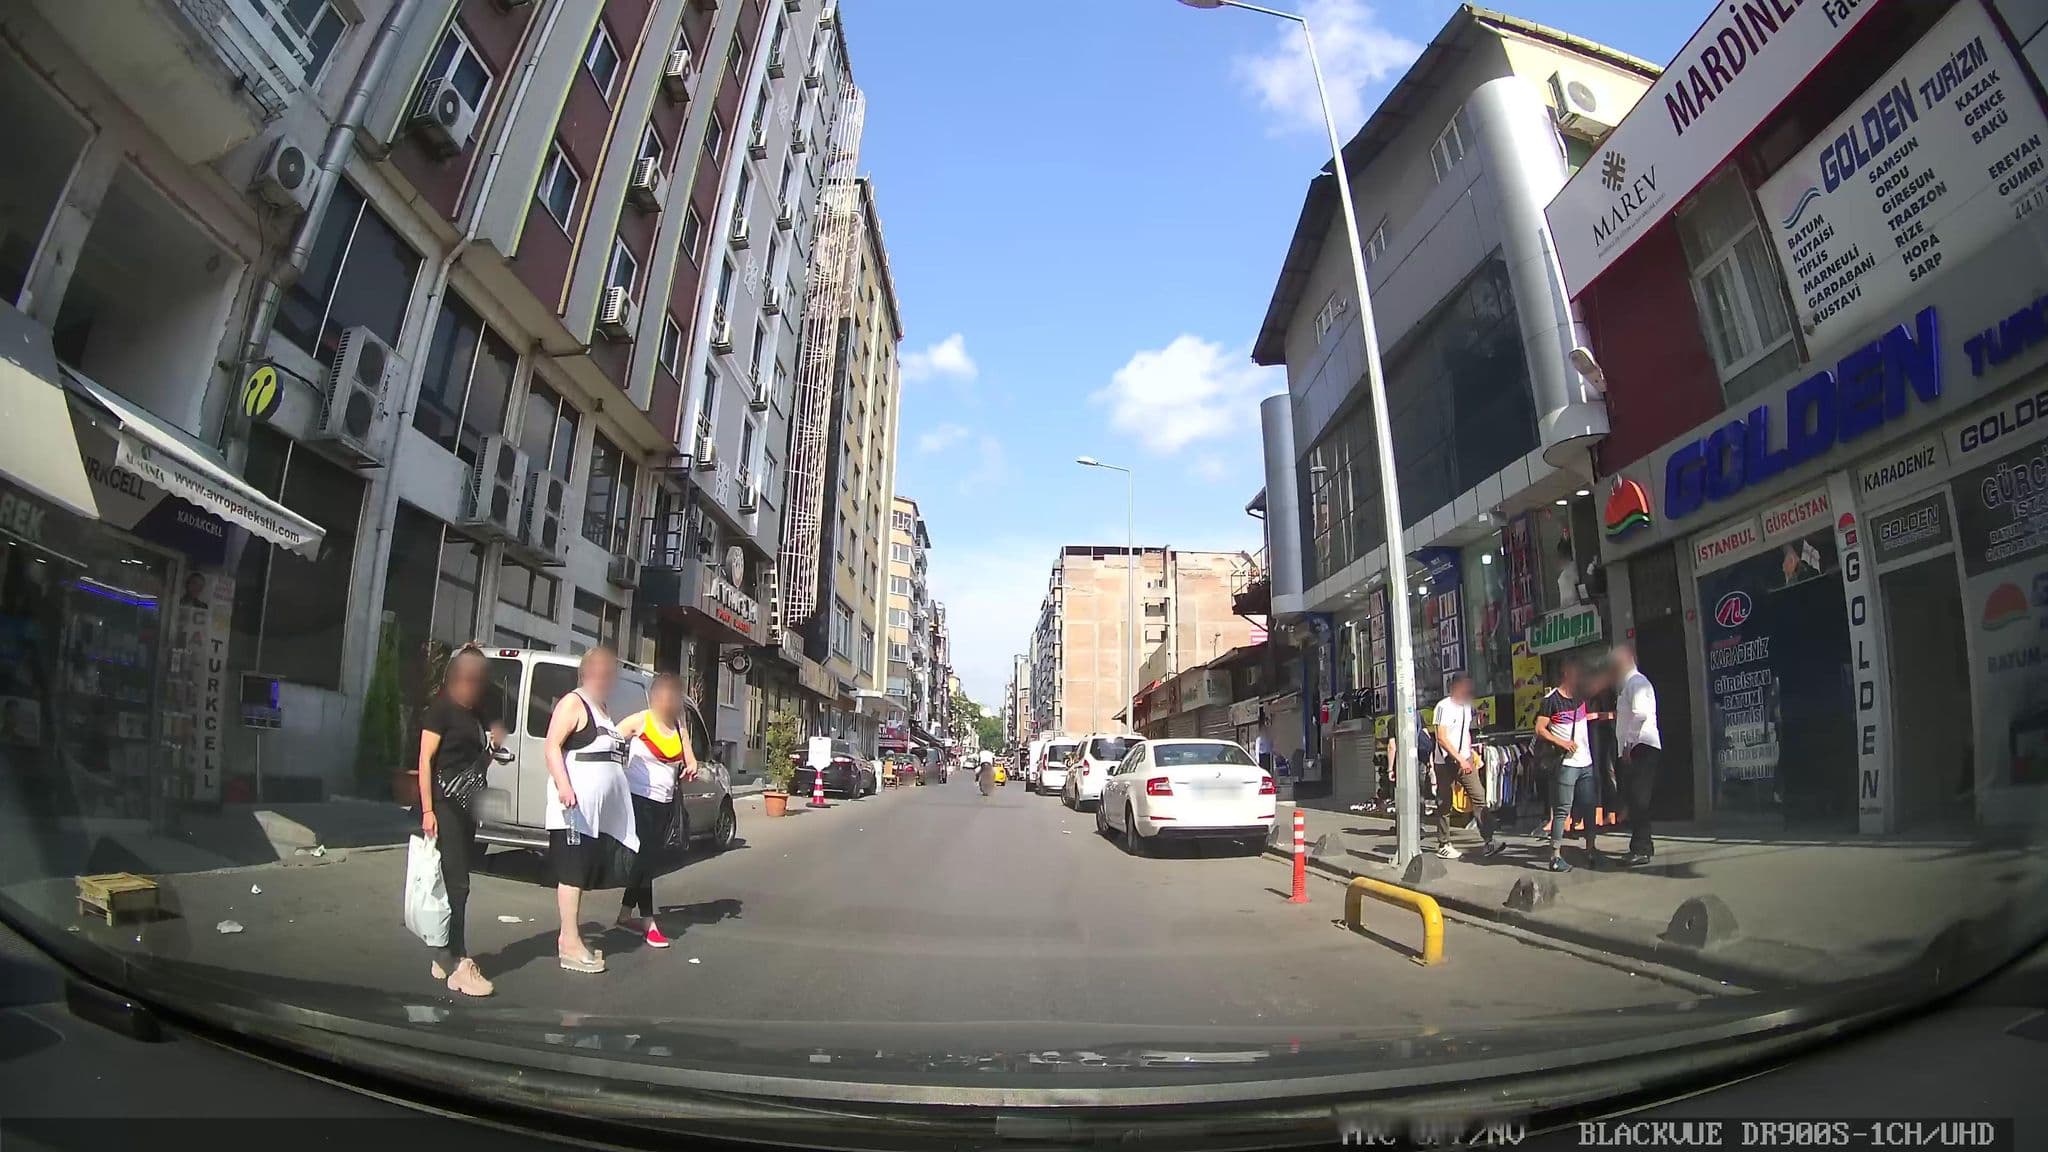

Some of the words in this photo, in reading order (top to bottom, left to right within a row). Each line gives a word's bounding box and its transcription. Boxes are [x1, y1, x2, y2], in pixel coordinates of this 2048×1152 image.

[1664, 0, 1806, 137] MARDİNL
[1954, 69, 2000, 111] KAZAK
[1819, 77, 1919, 194] GOLDEN
[1919, 35, 1989, 110] TURİZM
[1964, 89, 2006, 127] GENCE
[1972, 109, 2009, 145] BAKÜ
[1868, 136, 1919, 184] SAMSUN
[1988, 134, 2041, 180] EREVAN
[1875, 165, 1910, 198] ORDU
[1882, 168, 1935, 214] GİRESUN
[1593, 164, 1657, 248] MAREV
[1887, 181, 1948, 231] TRABZON
[1787, 213, 1825, 250] BATUM
[1792, 222, 1835, 264] KUTAİSİ
[1894, 220, 1925, 248] RİZE
[1902, 233, 1940, 265] HOPA
[1797, 249, 1829, 279] TİFLİS
[1803, 243, 1860, 295] MARNEULİ
[1808, 252, 1876, 309] GARDABANİ
[1909, 252, 1943, 282] SARP
[1812, 283, 1862, 326] RUSTAVİ
[1664, 305, 1941, 520] GOLDEN
[1864, 446, 1936, 493] KARADENİZ
[174, 471, 301, 544] www.avropatekstil.com
[1765, 495, 1828, 534] GÜRCİSTAN
[1880, 504, 1939, 541] GOLDEN
[1697, 527, 1756, 561] İSTANBUL
[1846, 552, 1881, 800] GOLDEN
